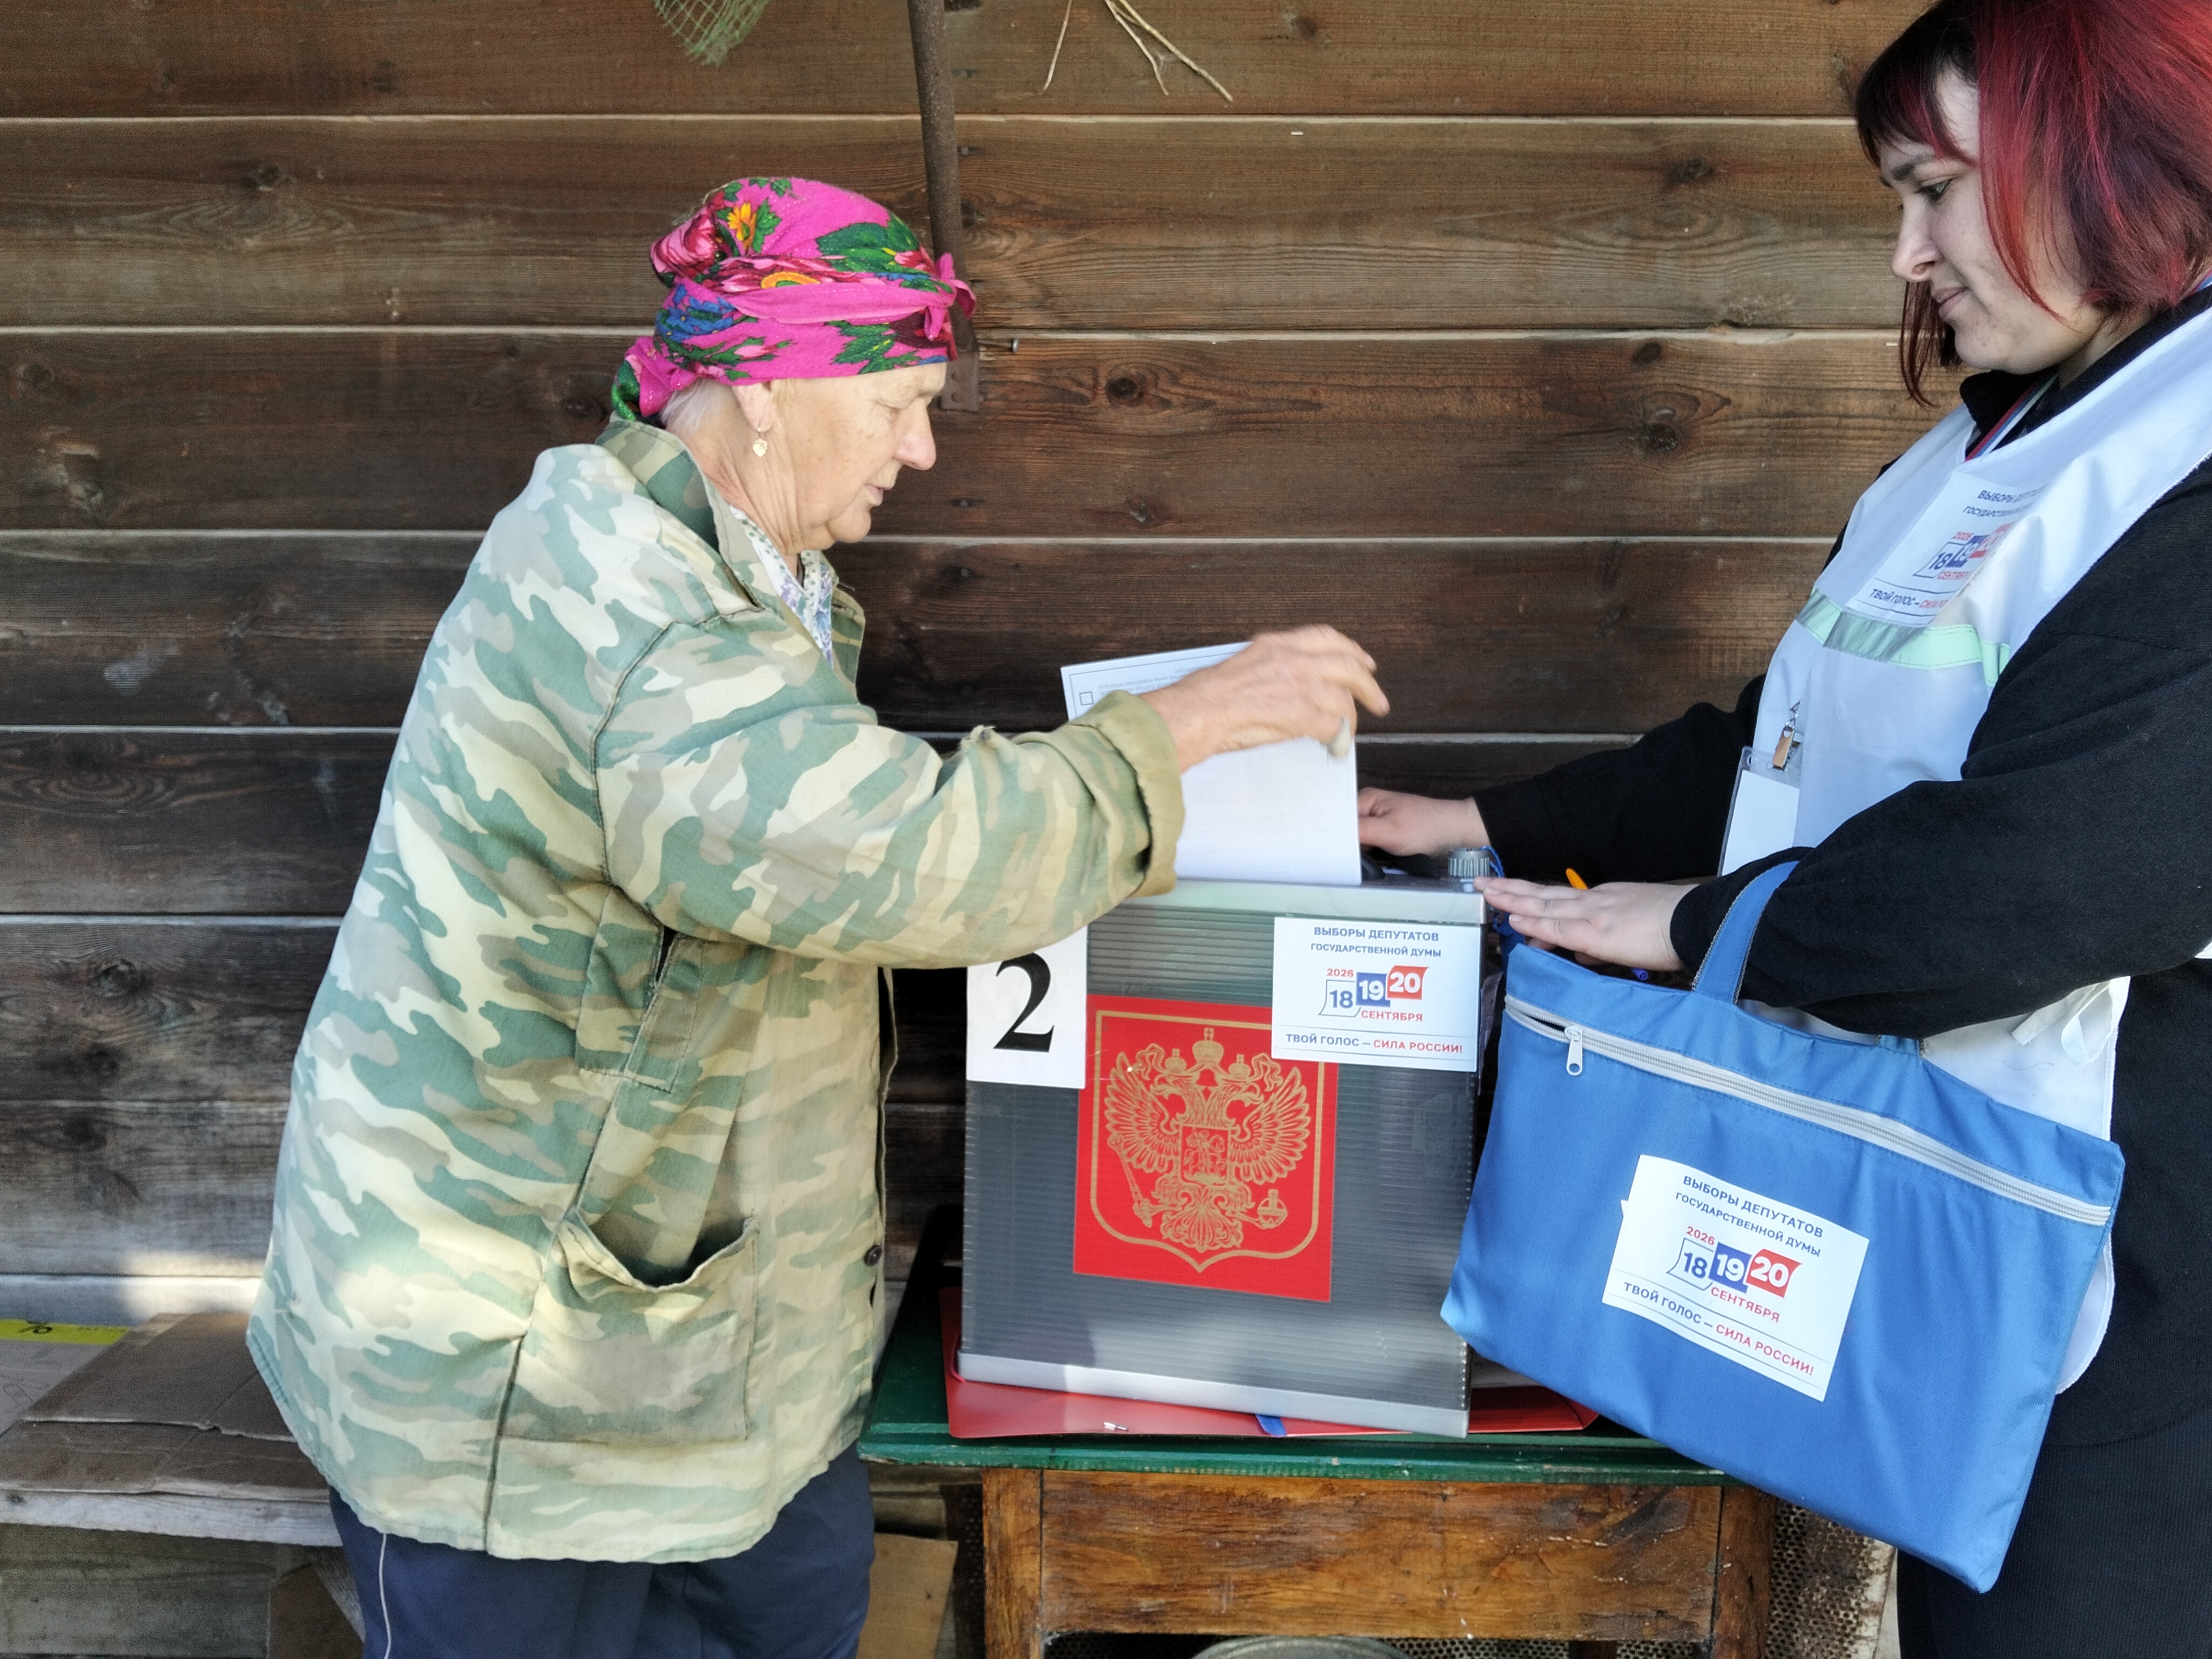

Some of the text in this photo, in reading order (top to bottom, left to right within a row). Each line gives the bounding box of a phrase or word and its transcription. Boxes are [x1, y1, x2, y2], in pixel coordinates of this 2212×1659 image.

[1977, 489, 2017, 503] ВЫБОРЫ
[1928, 551, 1953, 570] 18
[1953, 542, 1979, 562] 19
[1870, 588, 1895, 602] ТВОЙ
[1890, 595, 1916, 605] ГОЛОС
[1313, 926, 1439, 942] ВЫБОРЫ ДЕПУТАТОВ
[1311, 942, 1441, 957] ГОСУДАРСТВЕННОЙ ДУМЫ
[1326, 968, 1354, 977] 2026
[1329, 972, 1421, 1008] 18 19 20
[993, 952, 1055, 1053] 2
[1361, 1010, 1423, 1022] СЕНТЯБРЯ
[1285, 1033, 1317, 1044] ТВОЙ
[1320, 1035, 1360, 1047] ГОЛОС
[1373, 1040, 1406, 1050] СИЛА
[1409, 1042, 1463, 1054] РОССИИ!
[1683, 1175, 1824, 1238] ВЫБОРЫ ДЕПУТАТОВ
[1675, 1191, 1822, 1257] ГОСУДАРСТВЕННОЙ ДУМЫ
[1686, 1226, 1715, 1245] 2026
[1683, 1252, 1790, 1288] 18 19 20
[1710, 1285, 1781, 1323] СЕНТЯБРЯ
[1623, 1282, 1660, 1301] ТВОЙ
[1661, 1297, 1702, 1325] ГОЛОС
[1716, 1324, 1751, 1347] СИЛА
[1755, 1341, 1815, 1376] РОССИИ!
